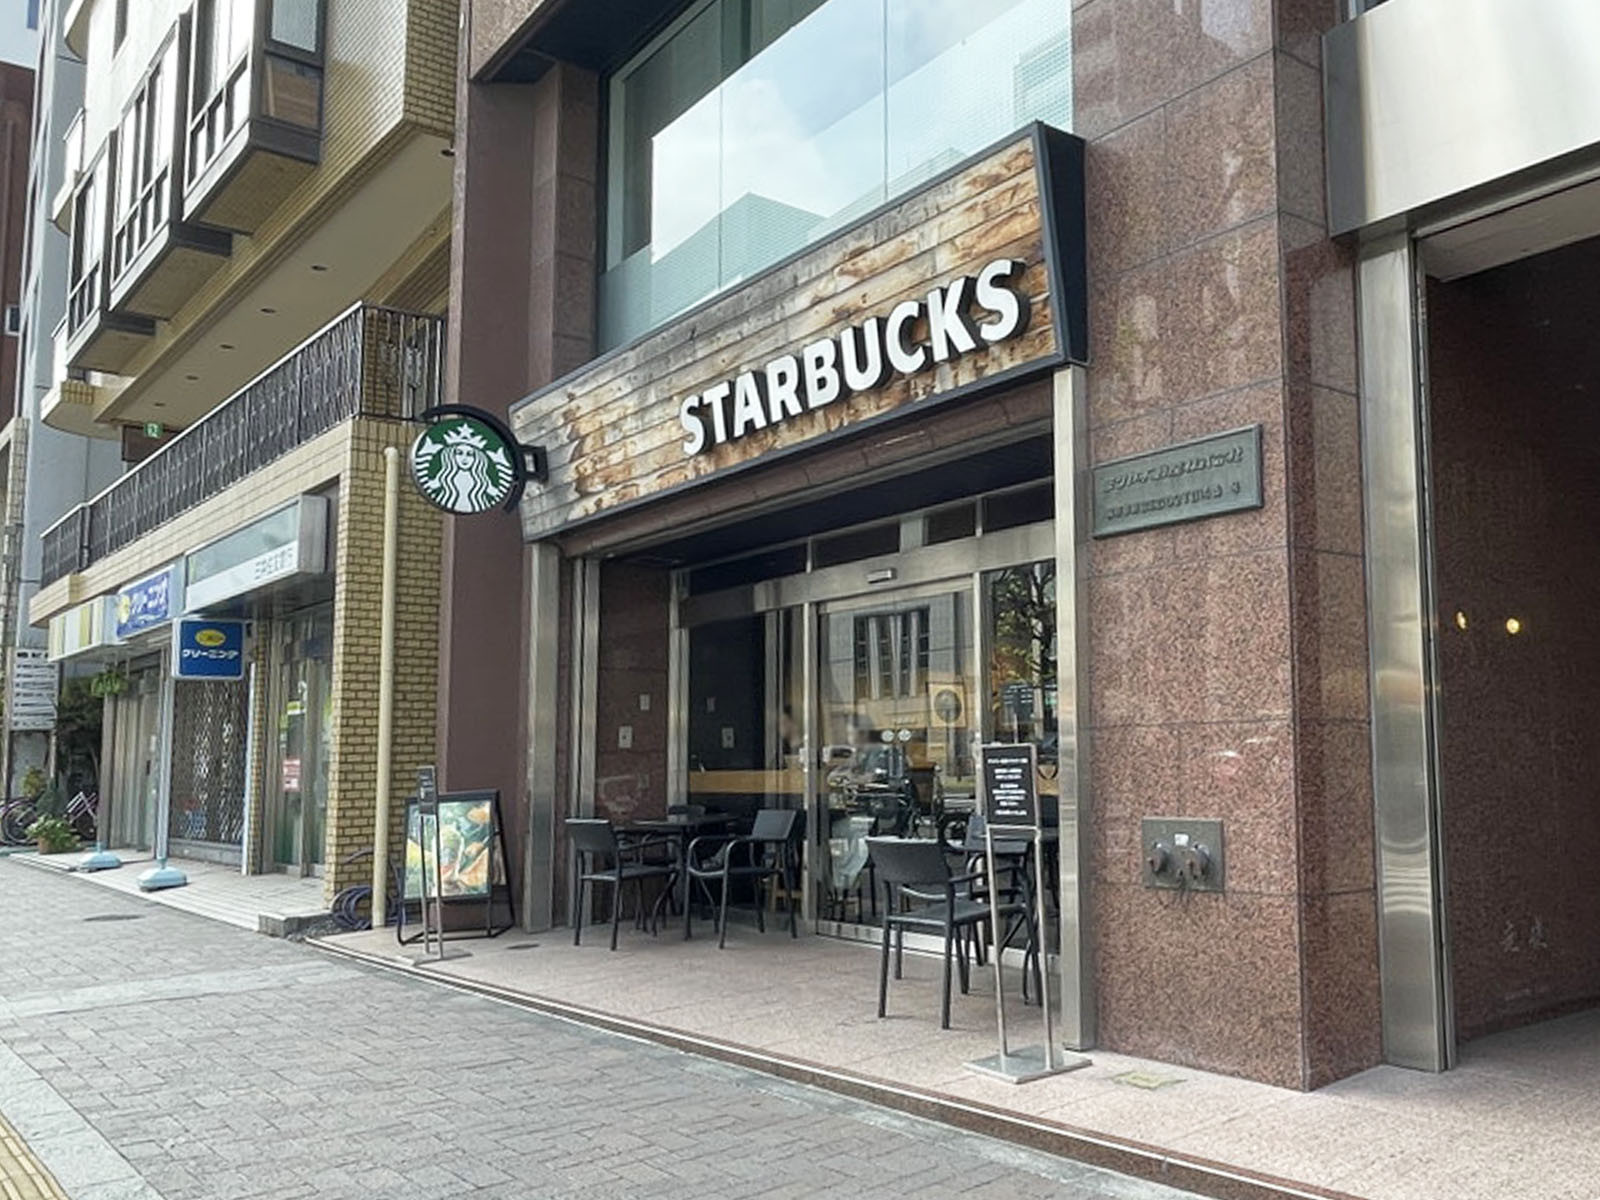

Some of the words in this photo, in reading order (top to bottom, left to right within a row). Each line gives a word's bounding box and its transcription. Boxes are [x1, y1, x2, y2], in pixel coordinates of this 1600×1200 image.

[679, 259, 1024, 456] STARBUCKS
[182, 649, 239, 660] クリーニング
